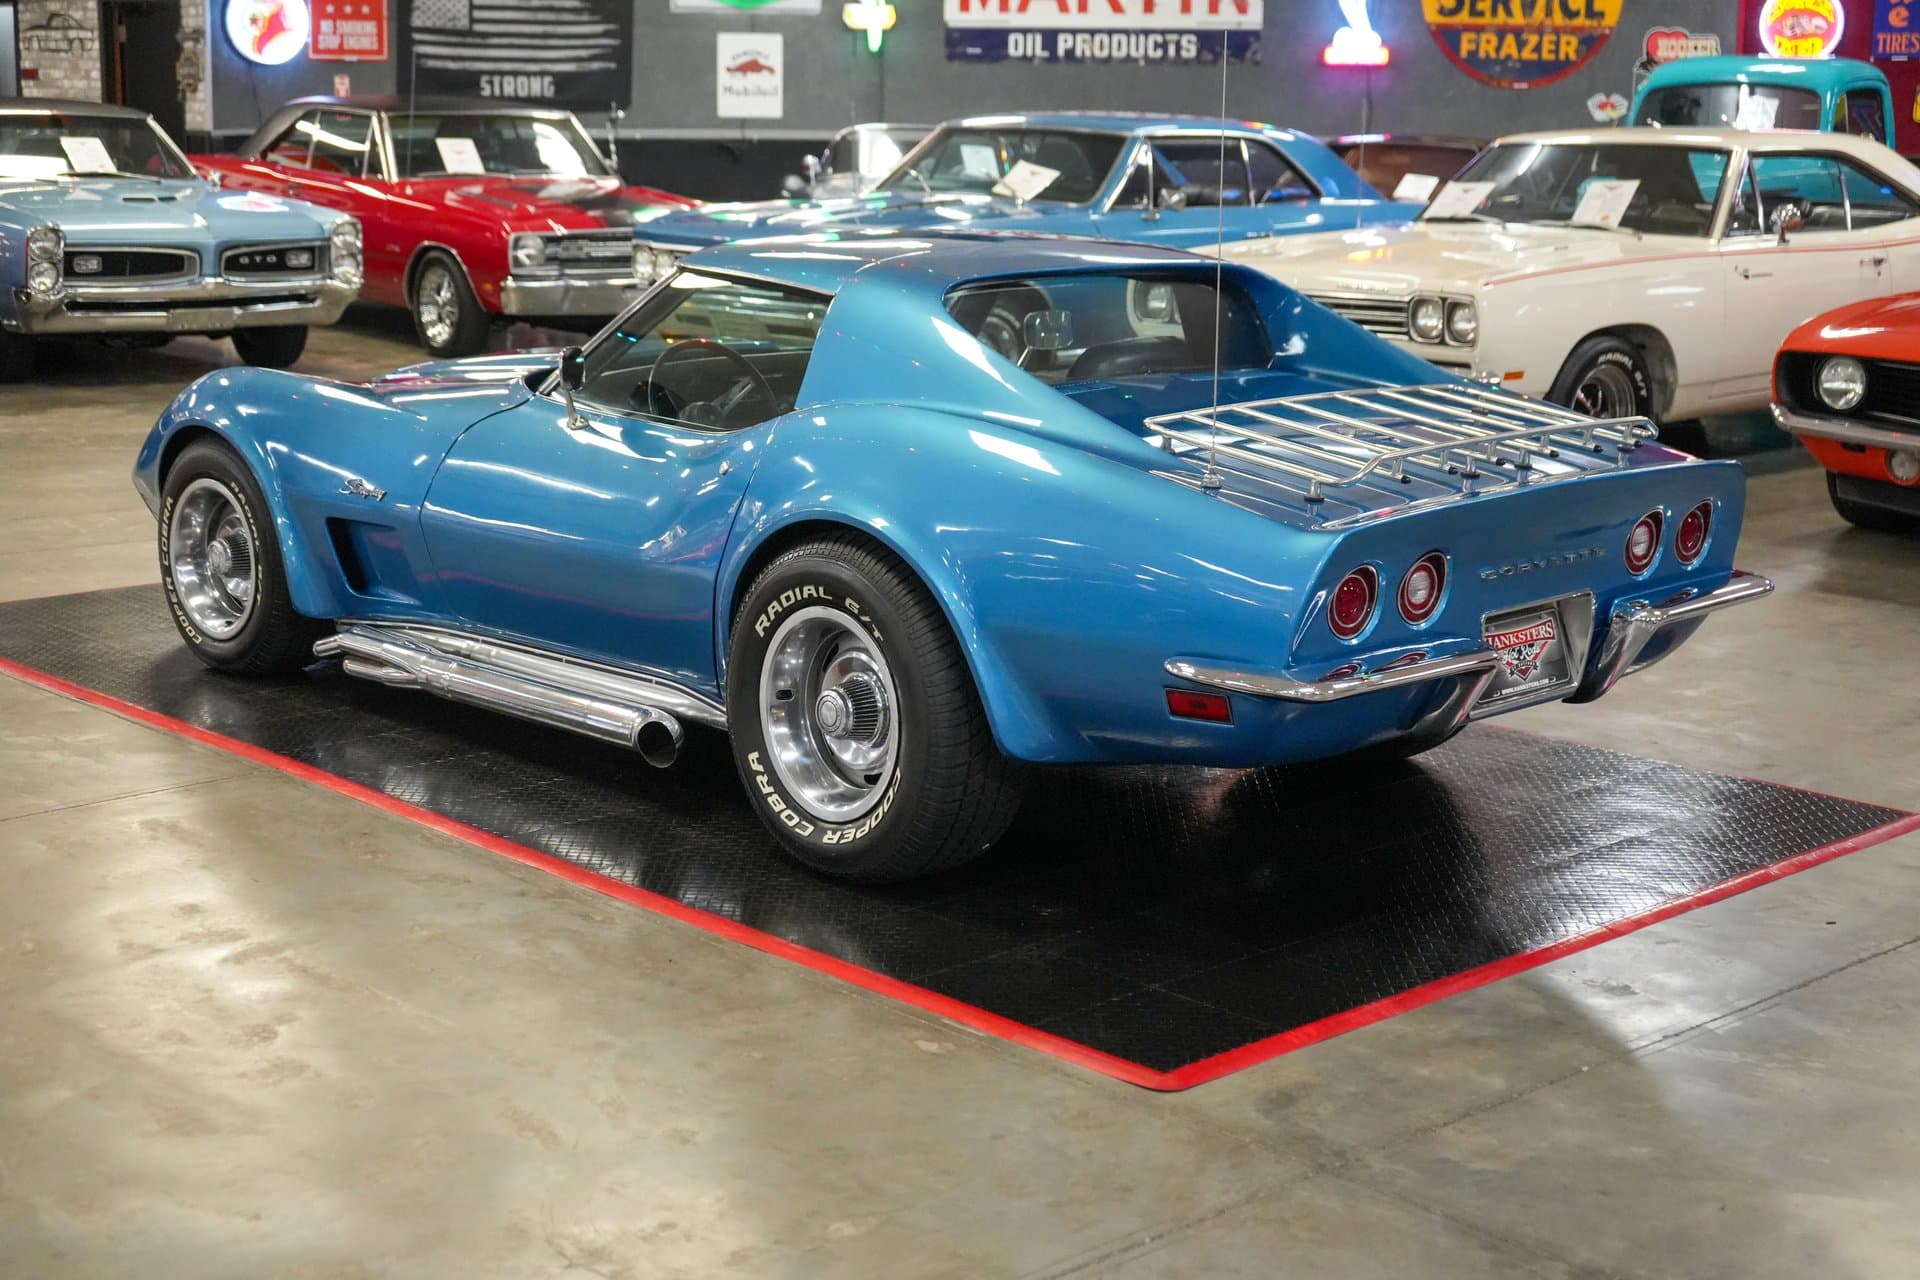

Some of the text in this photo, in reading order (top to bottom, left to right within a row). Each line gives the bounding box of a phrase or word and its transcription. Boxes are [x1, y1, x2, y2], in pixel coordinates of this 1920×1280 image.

[1008, 32, 1198, 59] OIL PRODUCTS
[1459, 31, 1579, 61] FRAZER
[1657, 37, 1718, 58] HOOKER
[1876, 32, 1920, 54] TIRES
[480, 75, 555, 98] STRONG
[239, 254, 278, 265] GTO
[1597, 351, 1633, 370] RADIAL
[160, 496, 203, 645] COOPER COBRA
[754, 584, 833, 638] RADIAL
[747, 751, 902, 846] COOPER COBRA
